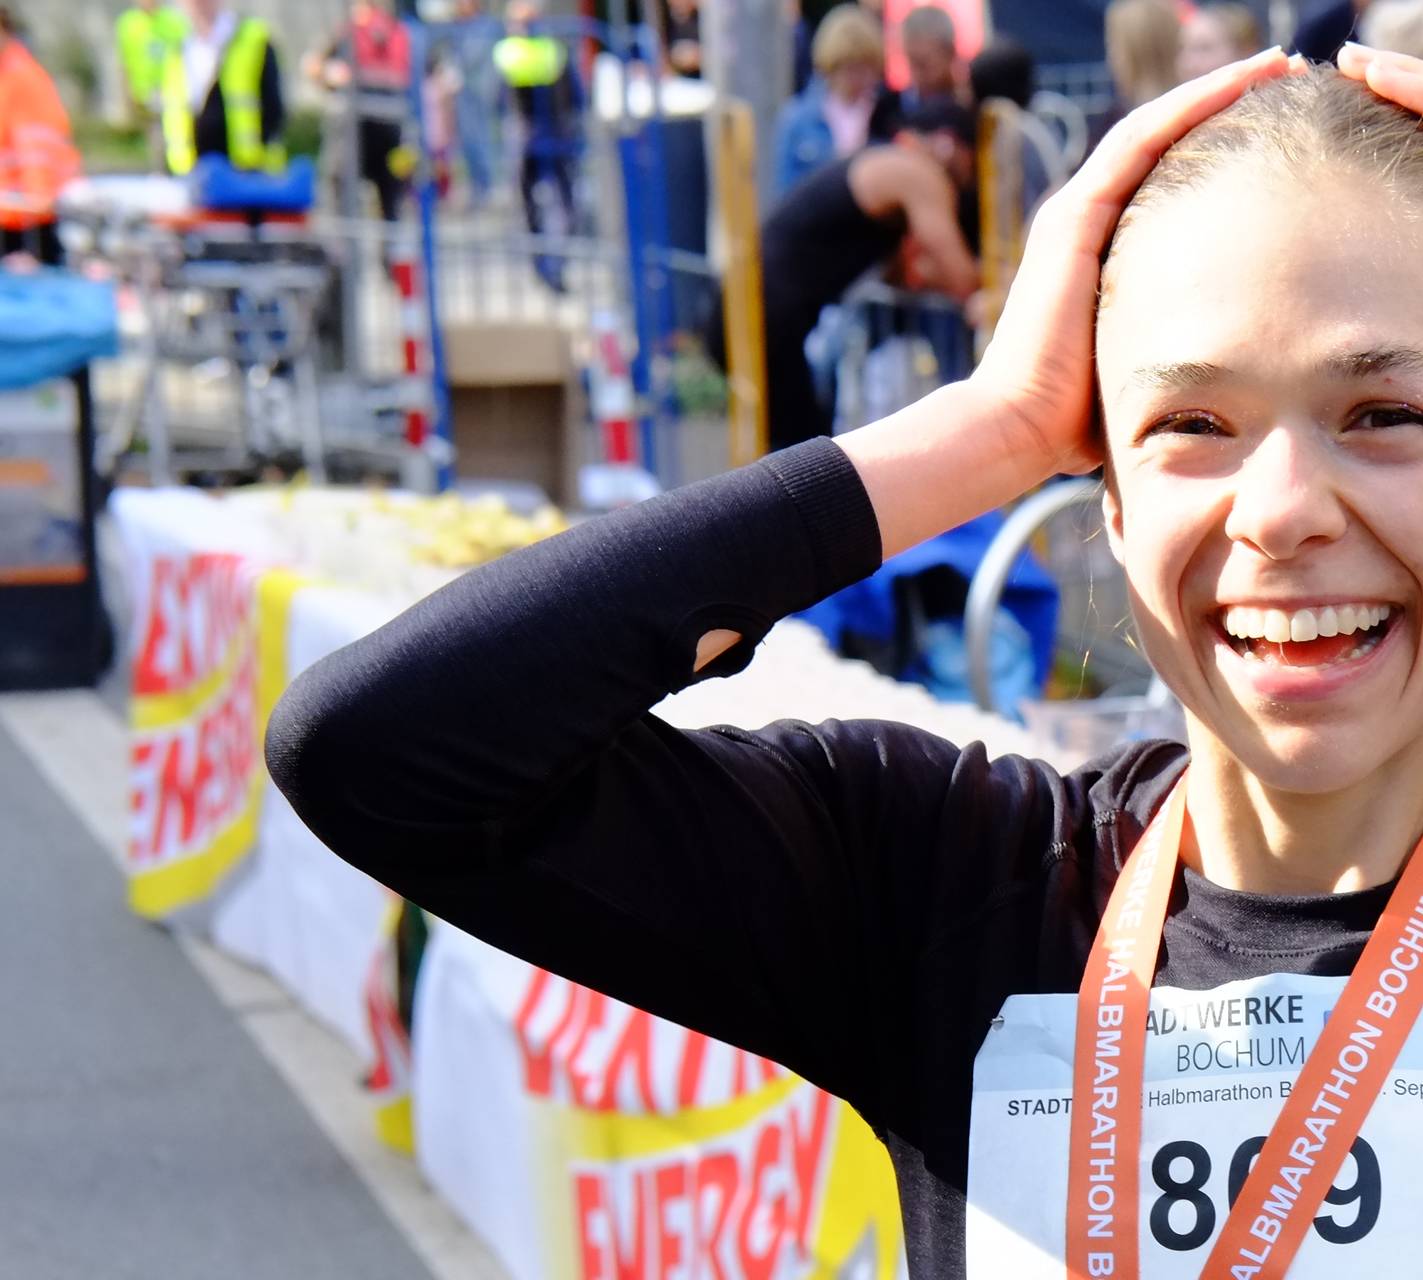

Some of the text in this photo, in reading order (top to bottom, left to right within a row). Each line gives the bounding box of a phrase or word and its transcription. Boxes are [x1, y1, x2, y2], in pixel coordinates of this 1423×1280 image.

[1146, 995, 1304, 1036] ADTWERKE
[1177, 1036, 1305, 1072] BOCHUM
[1007, 1098, 1073, 1117] STADT
[1150, 1083, 1272, 1107] Halbmarathon
[1087, 937, 1136, 1238] HALBMARATHON
[1231, 1019, 1384, 1280] ALBMARATHON
